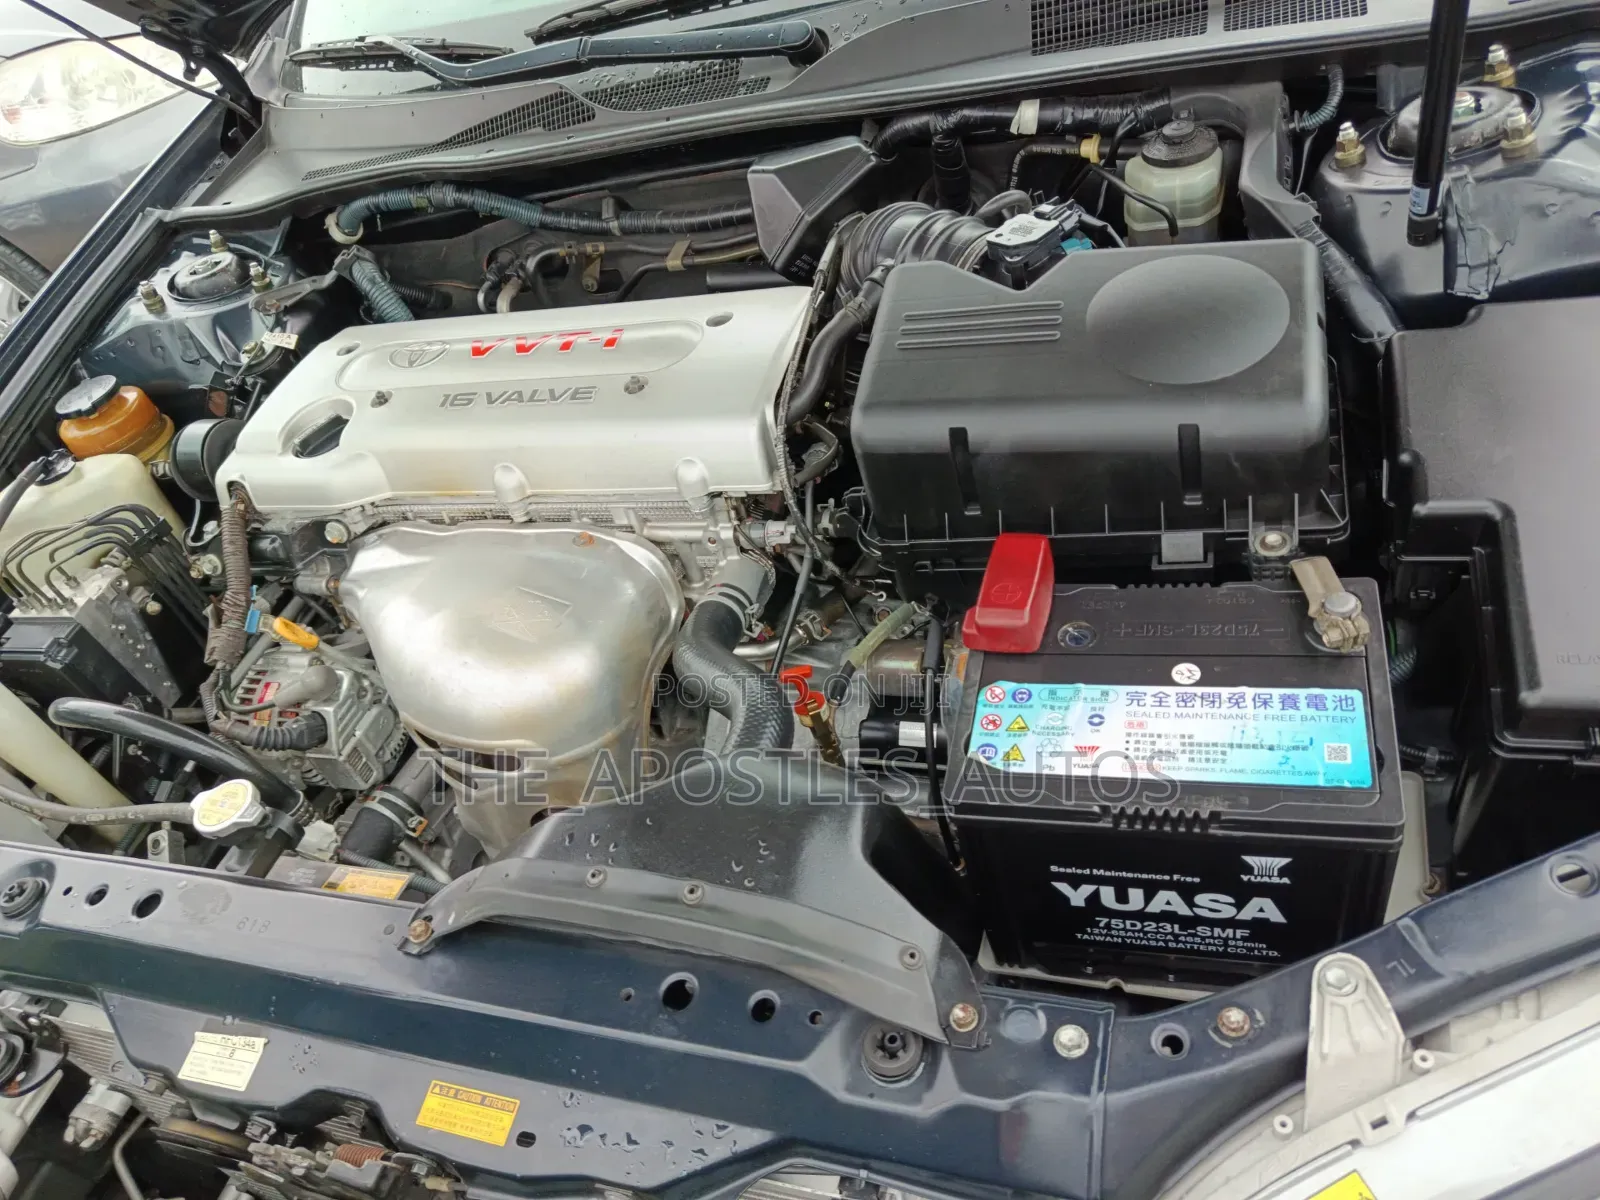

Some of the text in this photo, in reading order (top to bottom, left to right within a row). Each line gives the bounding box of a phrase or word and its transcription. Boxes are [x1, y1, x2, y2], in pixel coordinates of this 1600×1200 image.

[438, 385, 600, 409] 16 VALVE
[1125, 690, 1356, 713] 完全密閉免保養電池
[1126, 711, 1357, 724] SEALED MAINTENANCE FREE BATTERY
[1050, 865, 1201, 883] Sealed Maintenance Free
[1240, 875, 1292, 884] YUASA
[1051, 881, 1288, 923] YUASA
[1095, 917, 1251, 940] 75D23L-SMF
[1075, 932, 1122, 944] TAIWAN
[1125, 937, 1166, 948] YUASA
[1169, 941, 1225, 953] BATTERY
[1228, 939, 1267, 949] 95min
